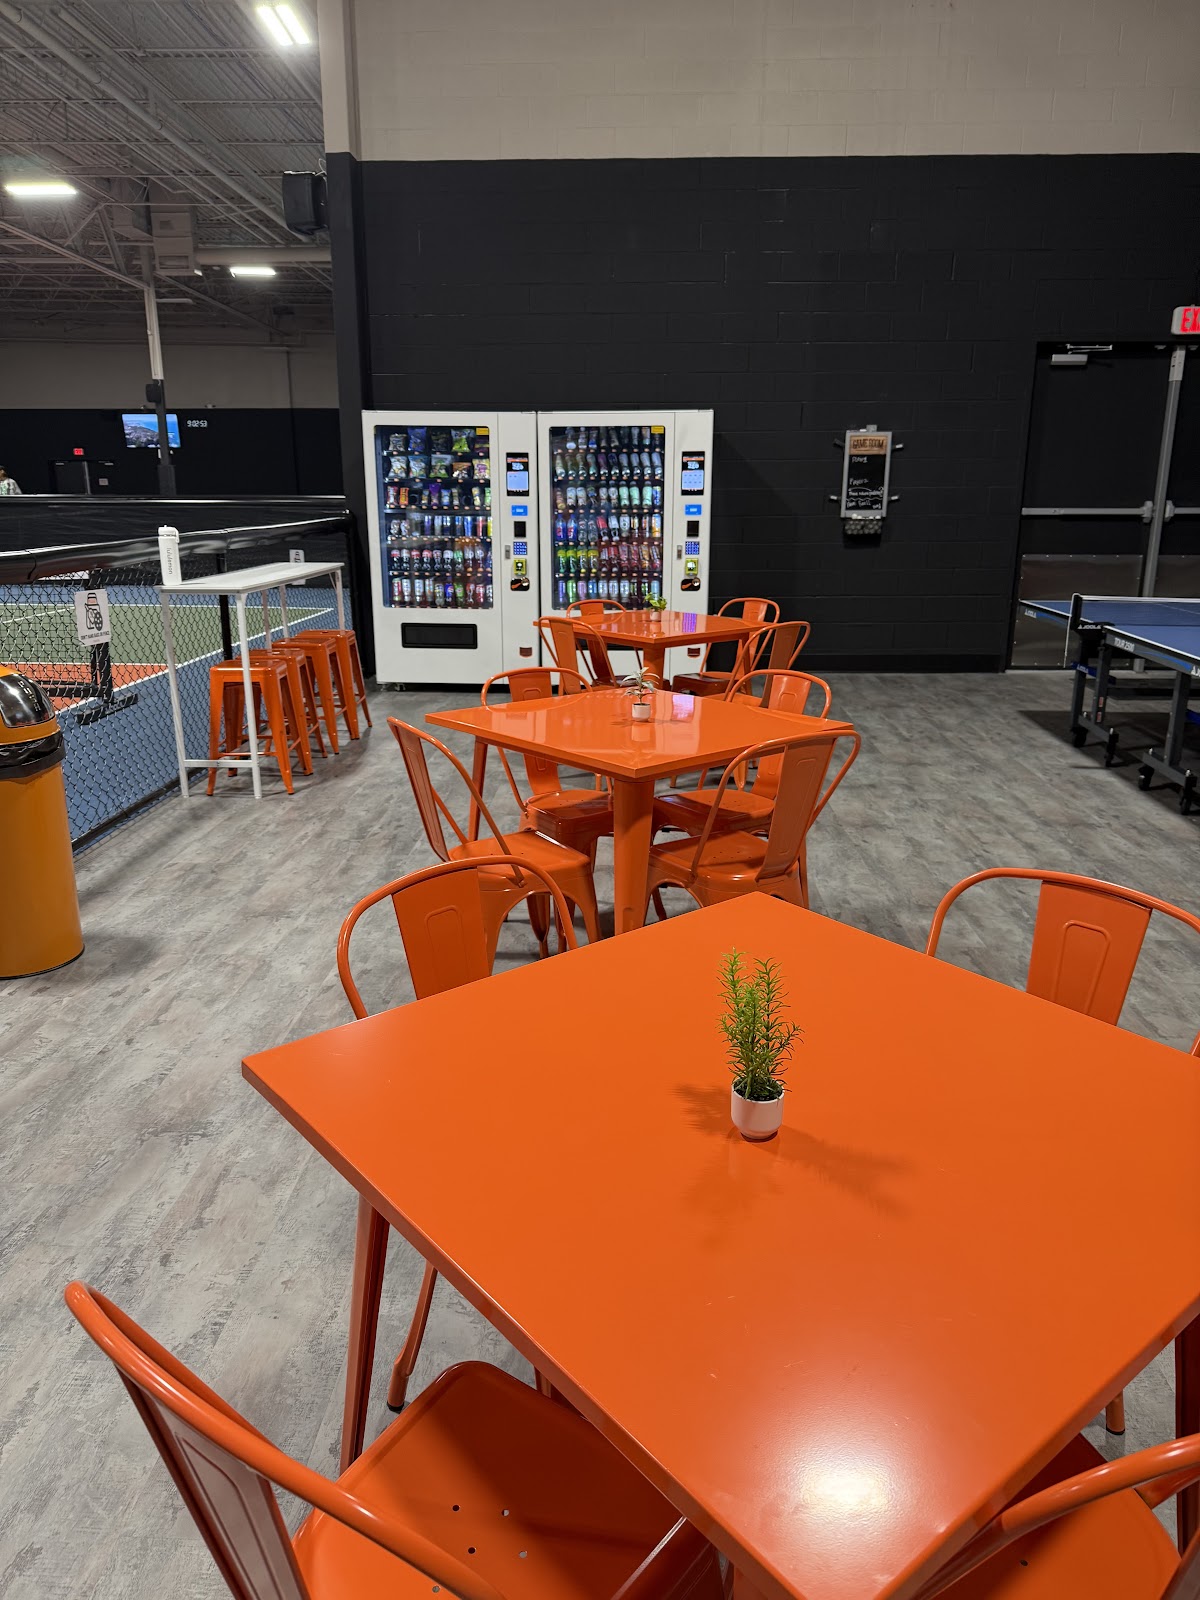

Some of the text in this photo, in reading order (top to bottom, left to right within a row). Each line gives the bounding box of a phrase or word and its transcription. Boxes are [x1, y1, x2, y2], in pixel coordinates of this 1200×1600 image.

[852, 438, 884, 449] GAME ROOM
[1114, 637, 1125, 648] TOUR
